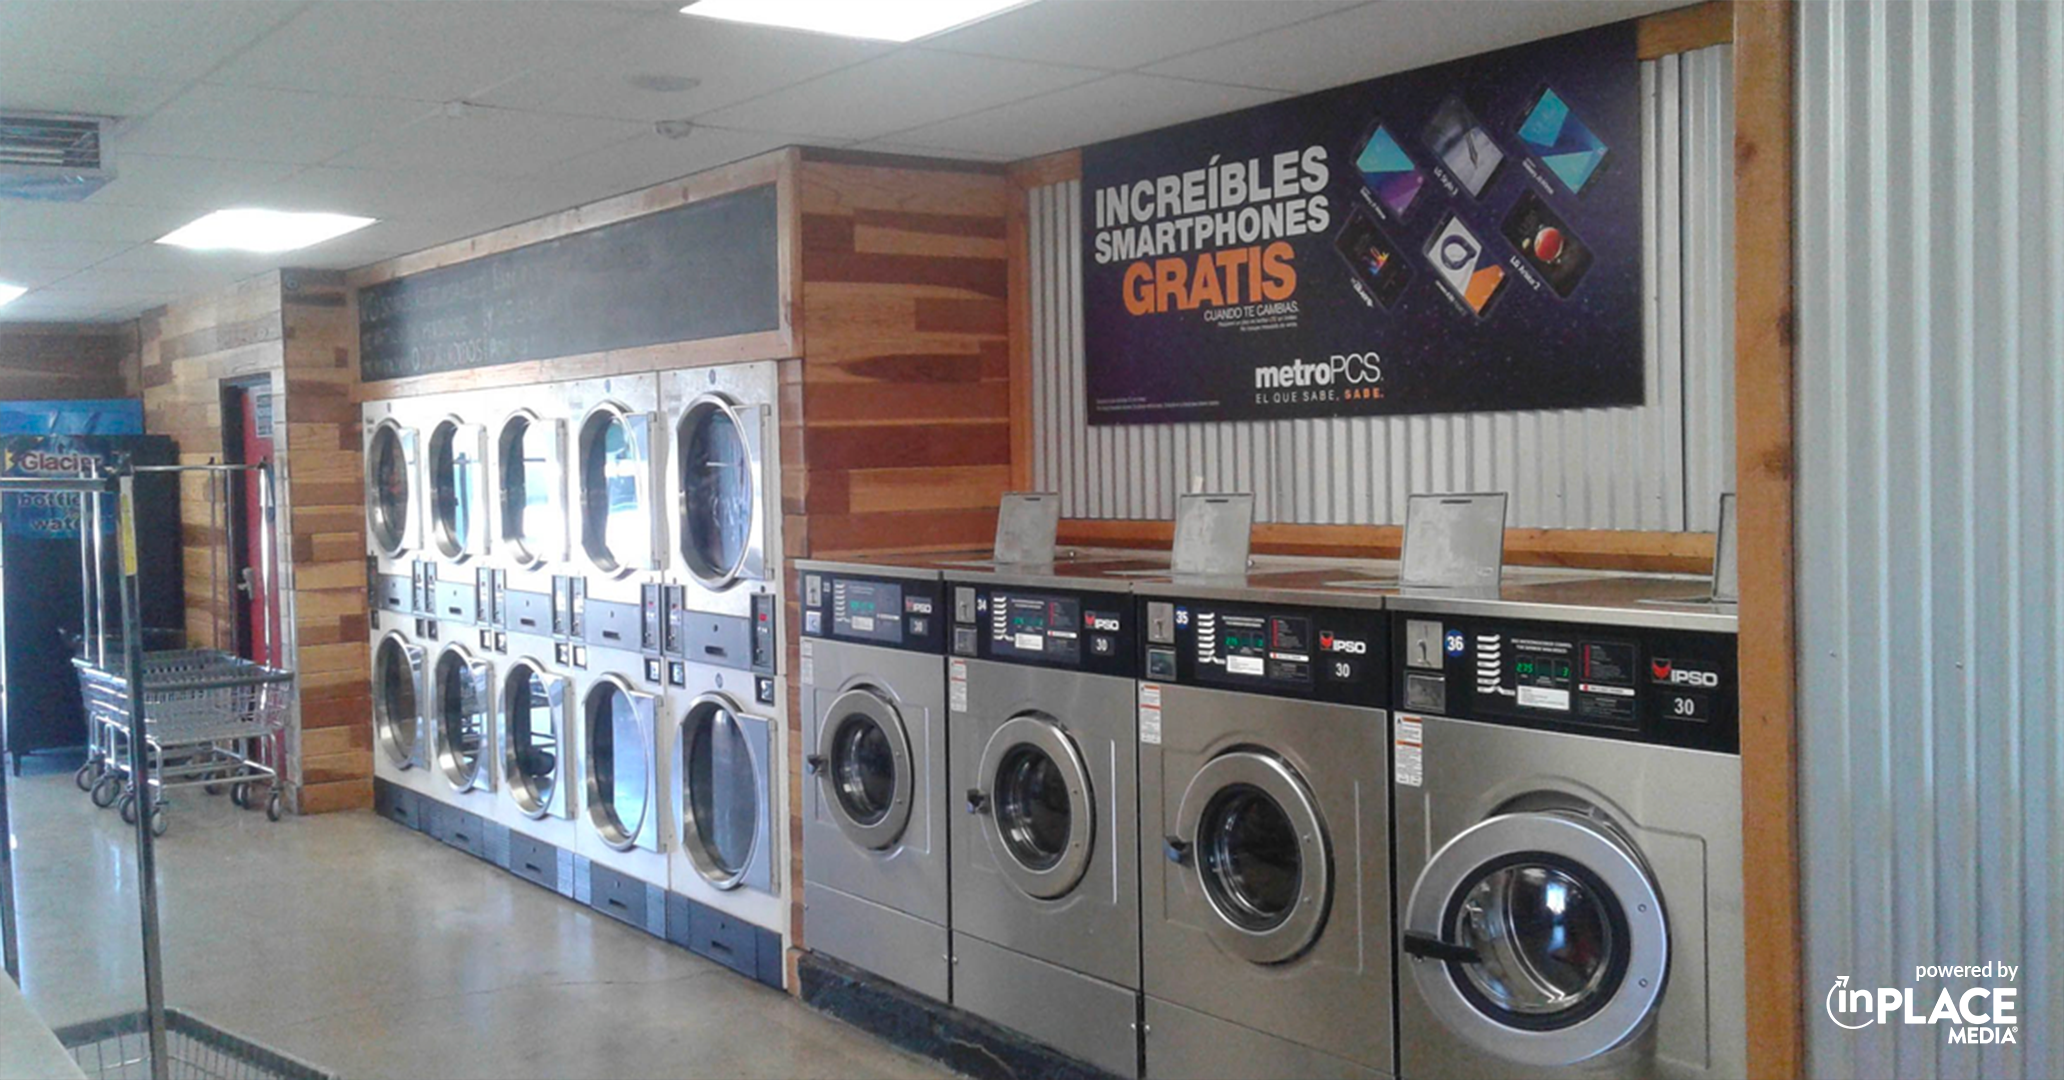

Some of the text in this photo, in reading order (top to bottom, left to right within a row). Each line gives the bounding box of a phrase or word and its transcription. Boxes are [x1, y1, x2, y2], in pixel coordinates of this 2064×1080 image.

[1096, 145, 1329, 228] INCREÍBLES
[1095, 195, 1330, 264] SMARTPHONES
[1122, 241, 1297, 316] GRATIS
[1203, 307, 1243, 322] CUANDO
[1244, 305, 1256, 317] TE
[1255, 393, 1269, 404] EL
[1273, 391, 1297, 404] QUE
[1176, 610, 1189, 624] 35
[1332, 639, 1367, 654] IPSO
[1447, 635, 1464, 651] 36
[1335, 662, 1351, 678] 30
[1671, 669, 1718, 687] IPSO
[1674, 697, 1695, 715] 30
